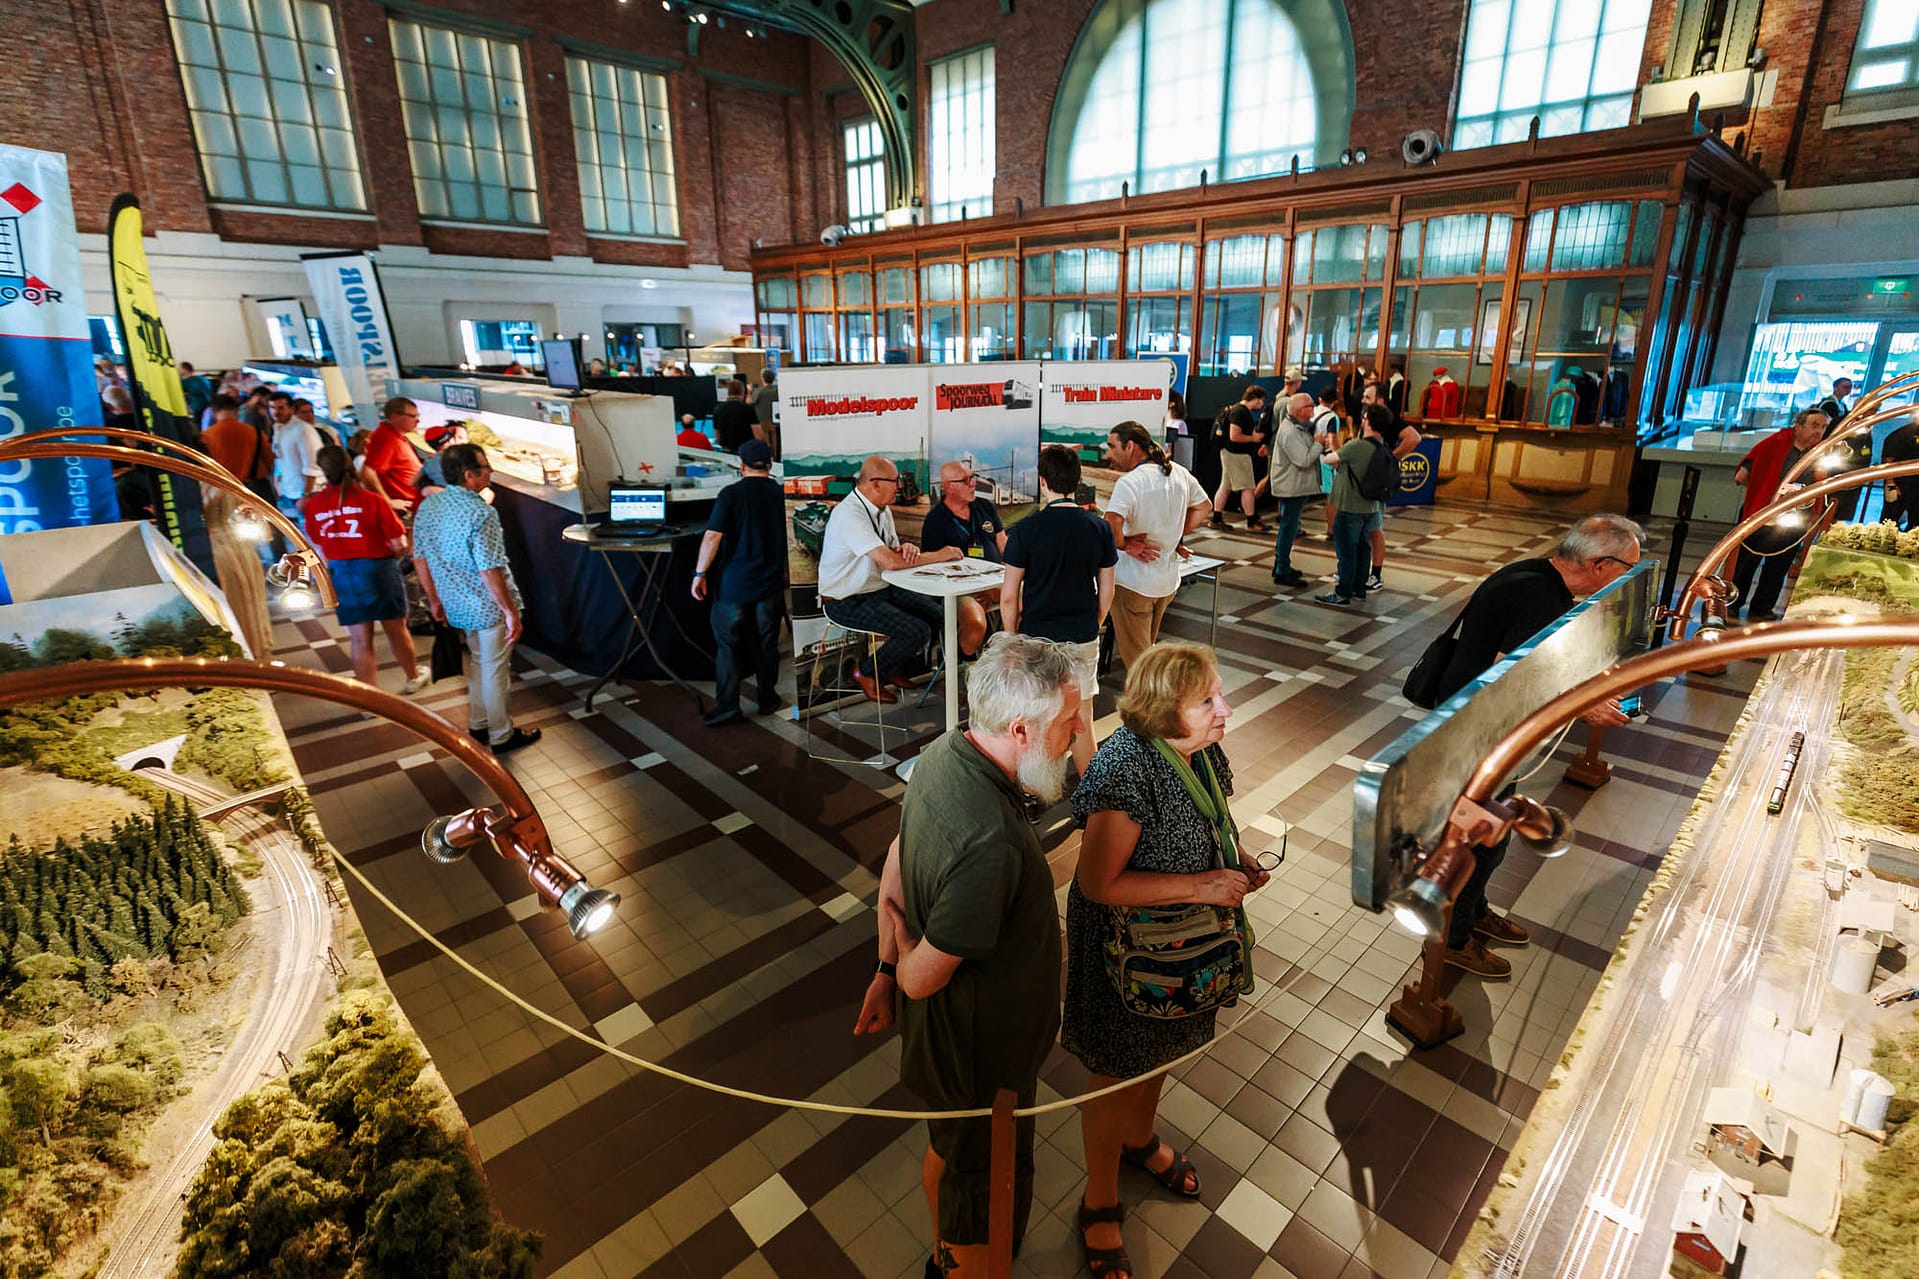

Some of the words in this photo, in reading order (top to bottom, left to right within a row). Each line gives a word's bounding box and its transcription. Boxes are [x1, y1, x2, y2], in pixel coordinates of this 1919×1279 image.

[940, 384, 991, 400] Spoorweg
[1063, 386, 1098, 403] Train
[1099, 385, 1162, 402] Miniature
[807, 396, 918, 416] Modelspoor
